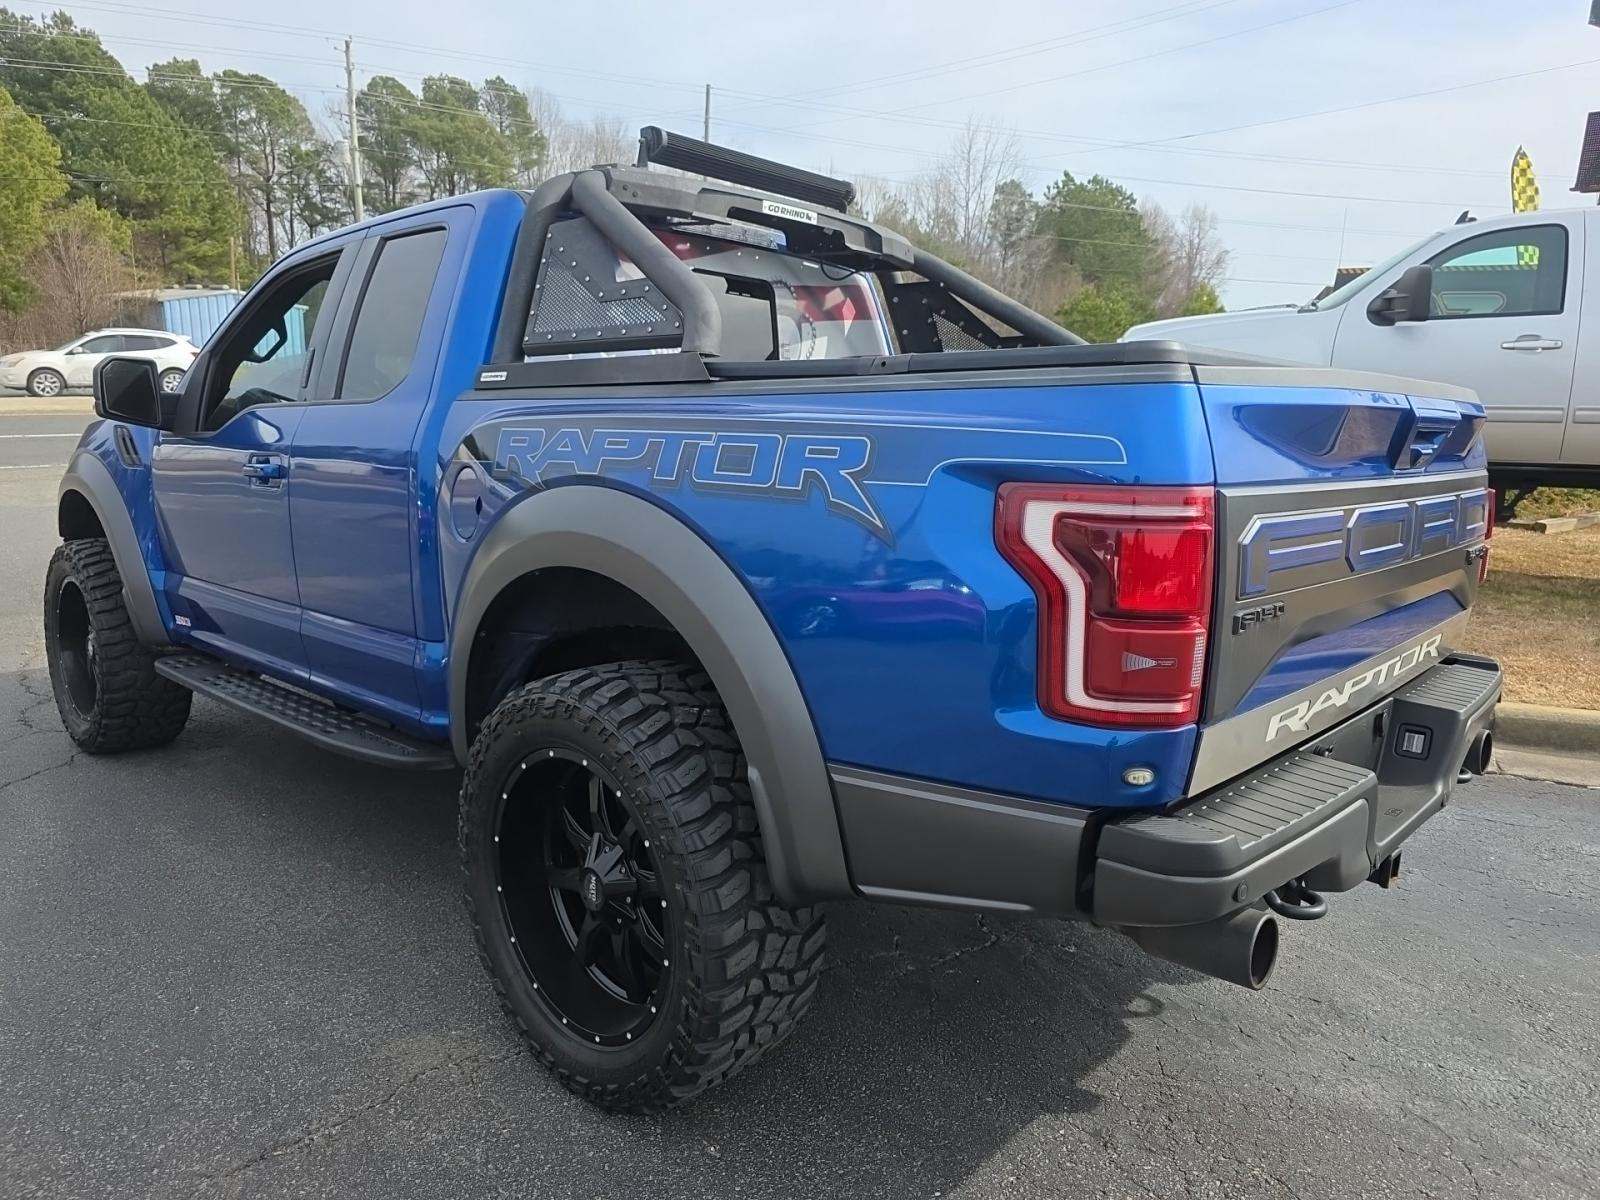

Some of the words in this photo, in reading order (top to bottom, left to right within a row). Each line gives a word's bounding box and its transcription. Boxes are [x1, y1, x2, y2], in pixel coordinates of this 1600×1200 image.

[768, 204, 779, 213] GO
[781, 206, 805, 218] RHINO
[495, 428, 884, 528] RAPTOR
[1237, 489, 1487, 600] FORD
[1265, 633, 1443, 742] RAPTOR
